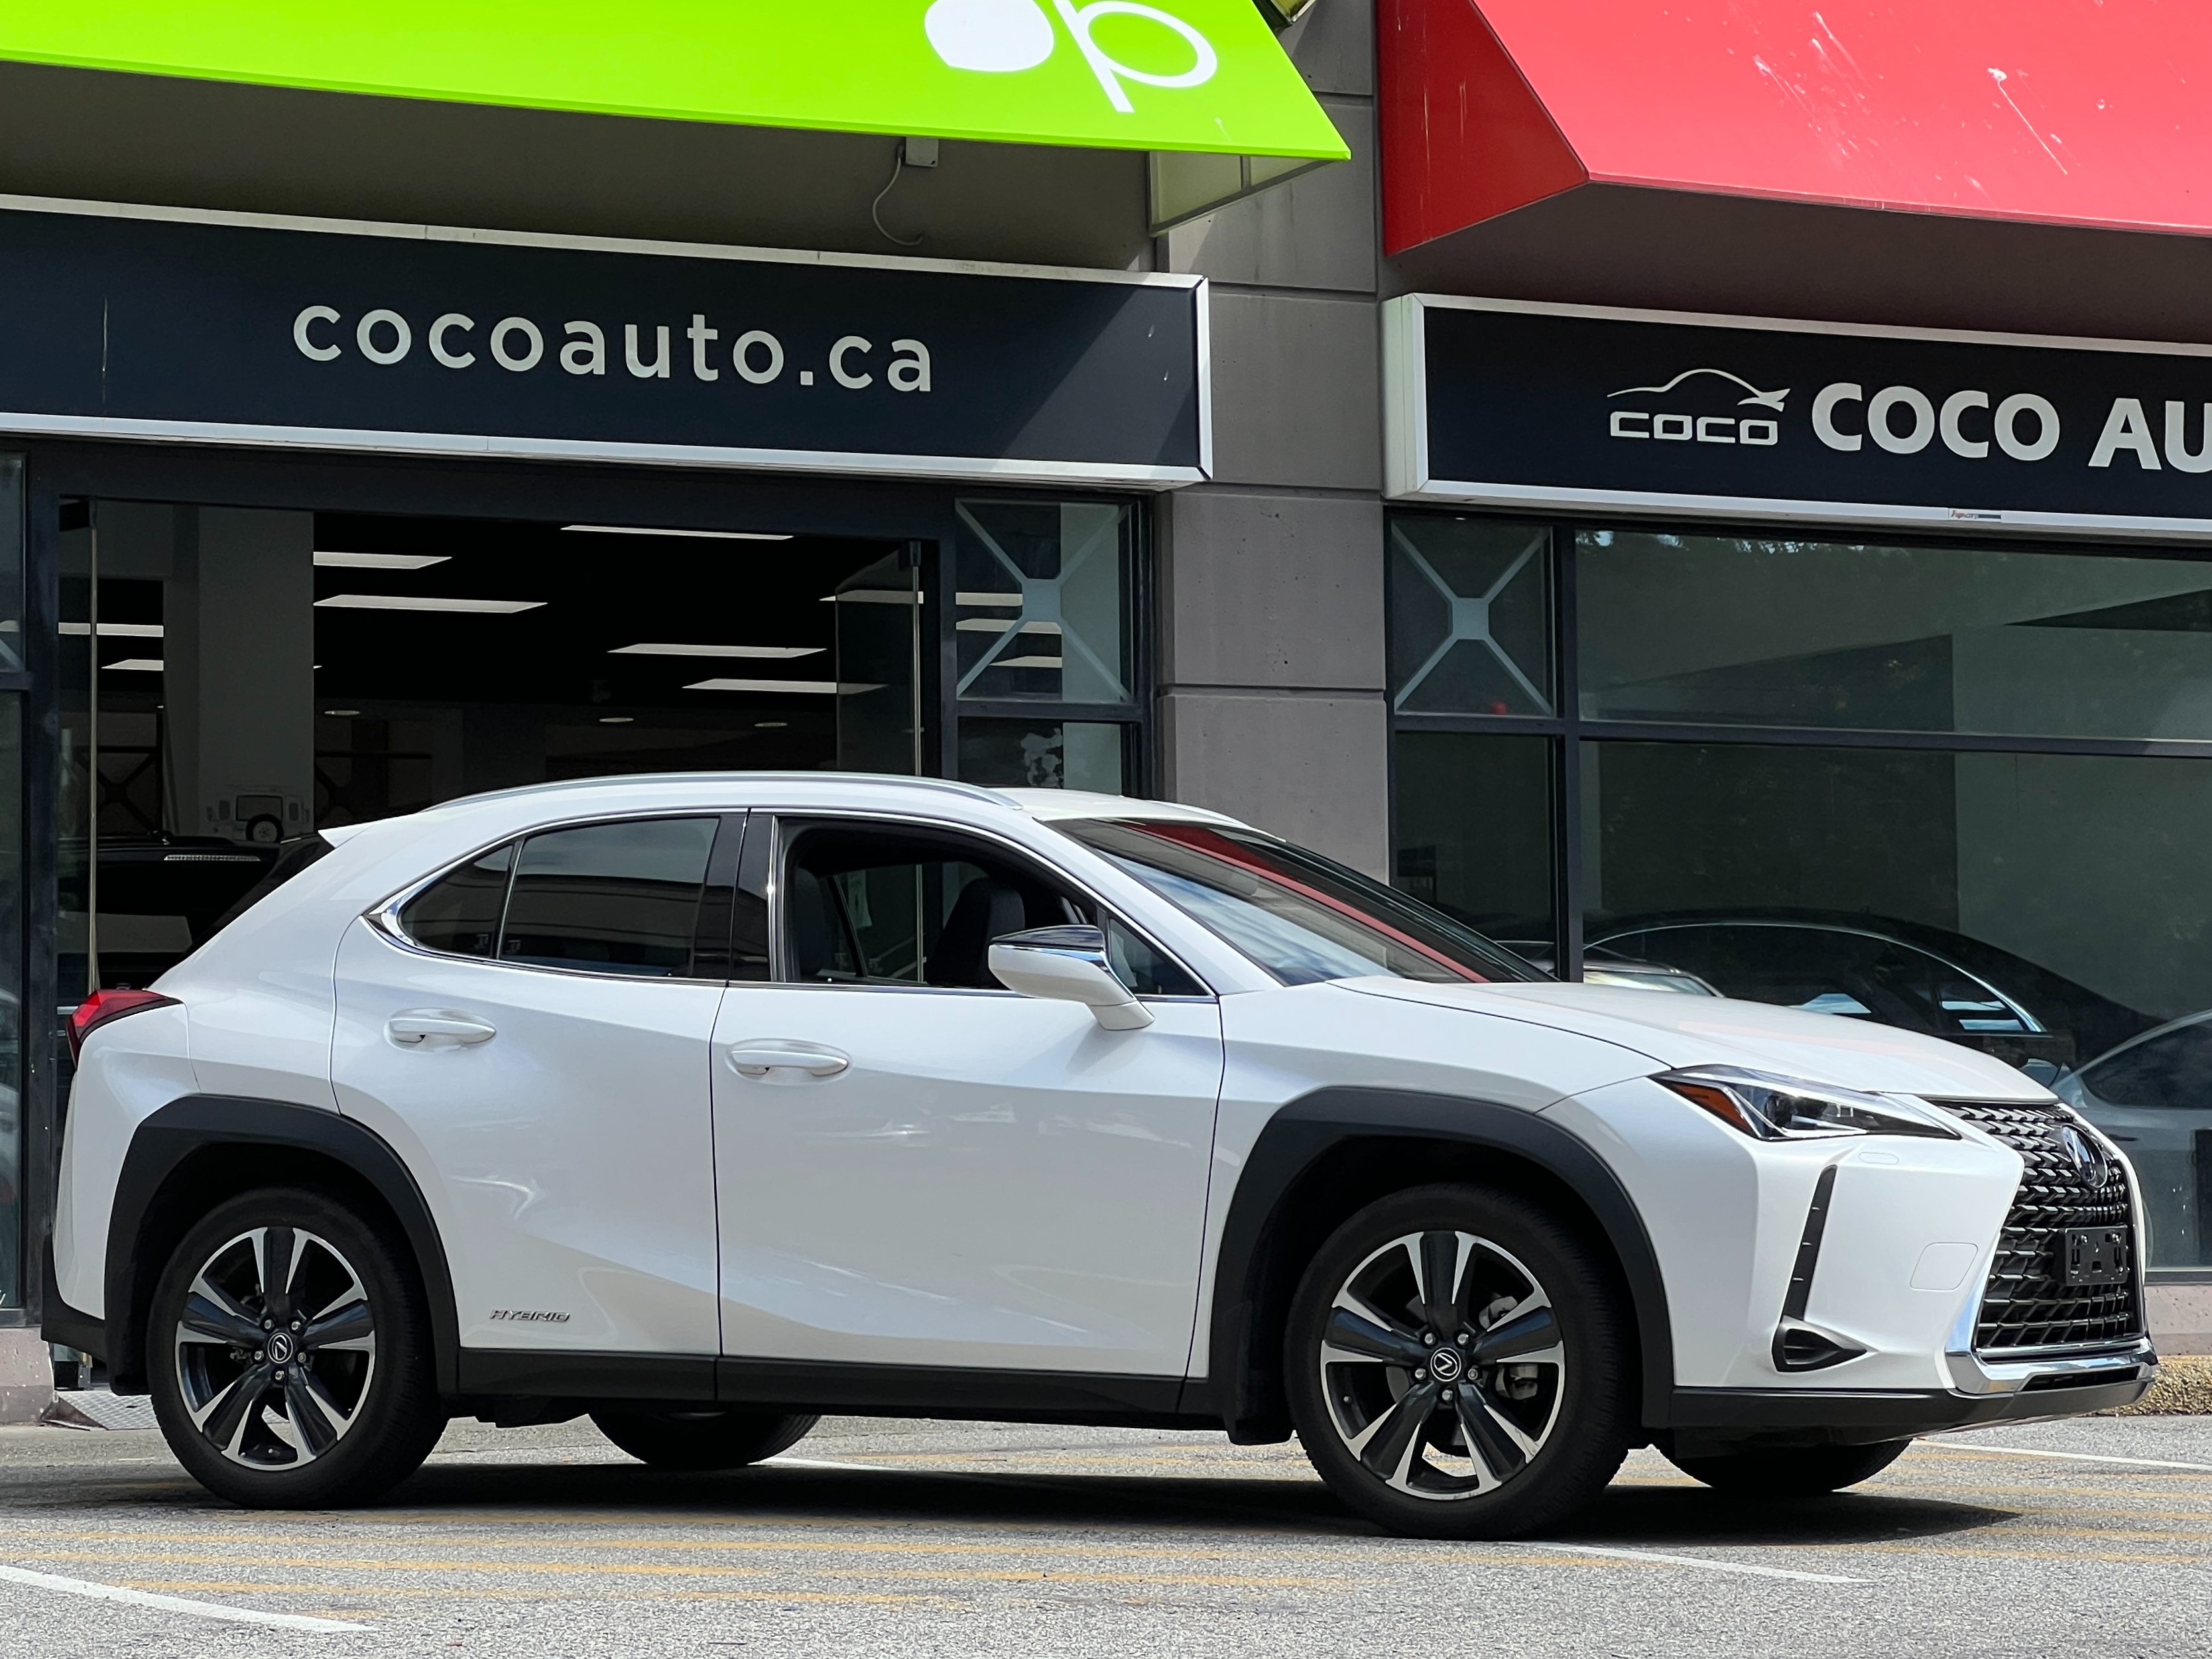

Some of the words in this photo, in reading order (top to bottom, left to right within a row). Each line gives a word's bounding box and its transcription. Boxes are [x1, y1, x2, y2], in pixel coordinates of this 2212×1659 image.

[294, 305, 932, 393] cocoauto.ca
[1610, 410, 1778, 446] COCO
[1812, 382, 2060, 461] COCO
[2088, 397, 2212, 473] AU
[489, 1309, 570, 1322] HYBRID
